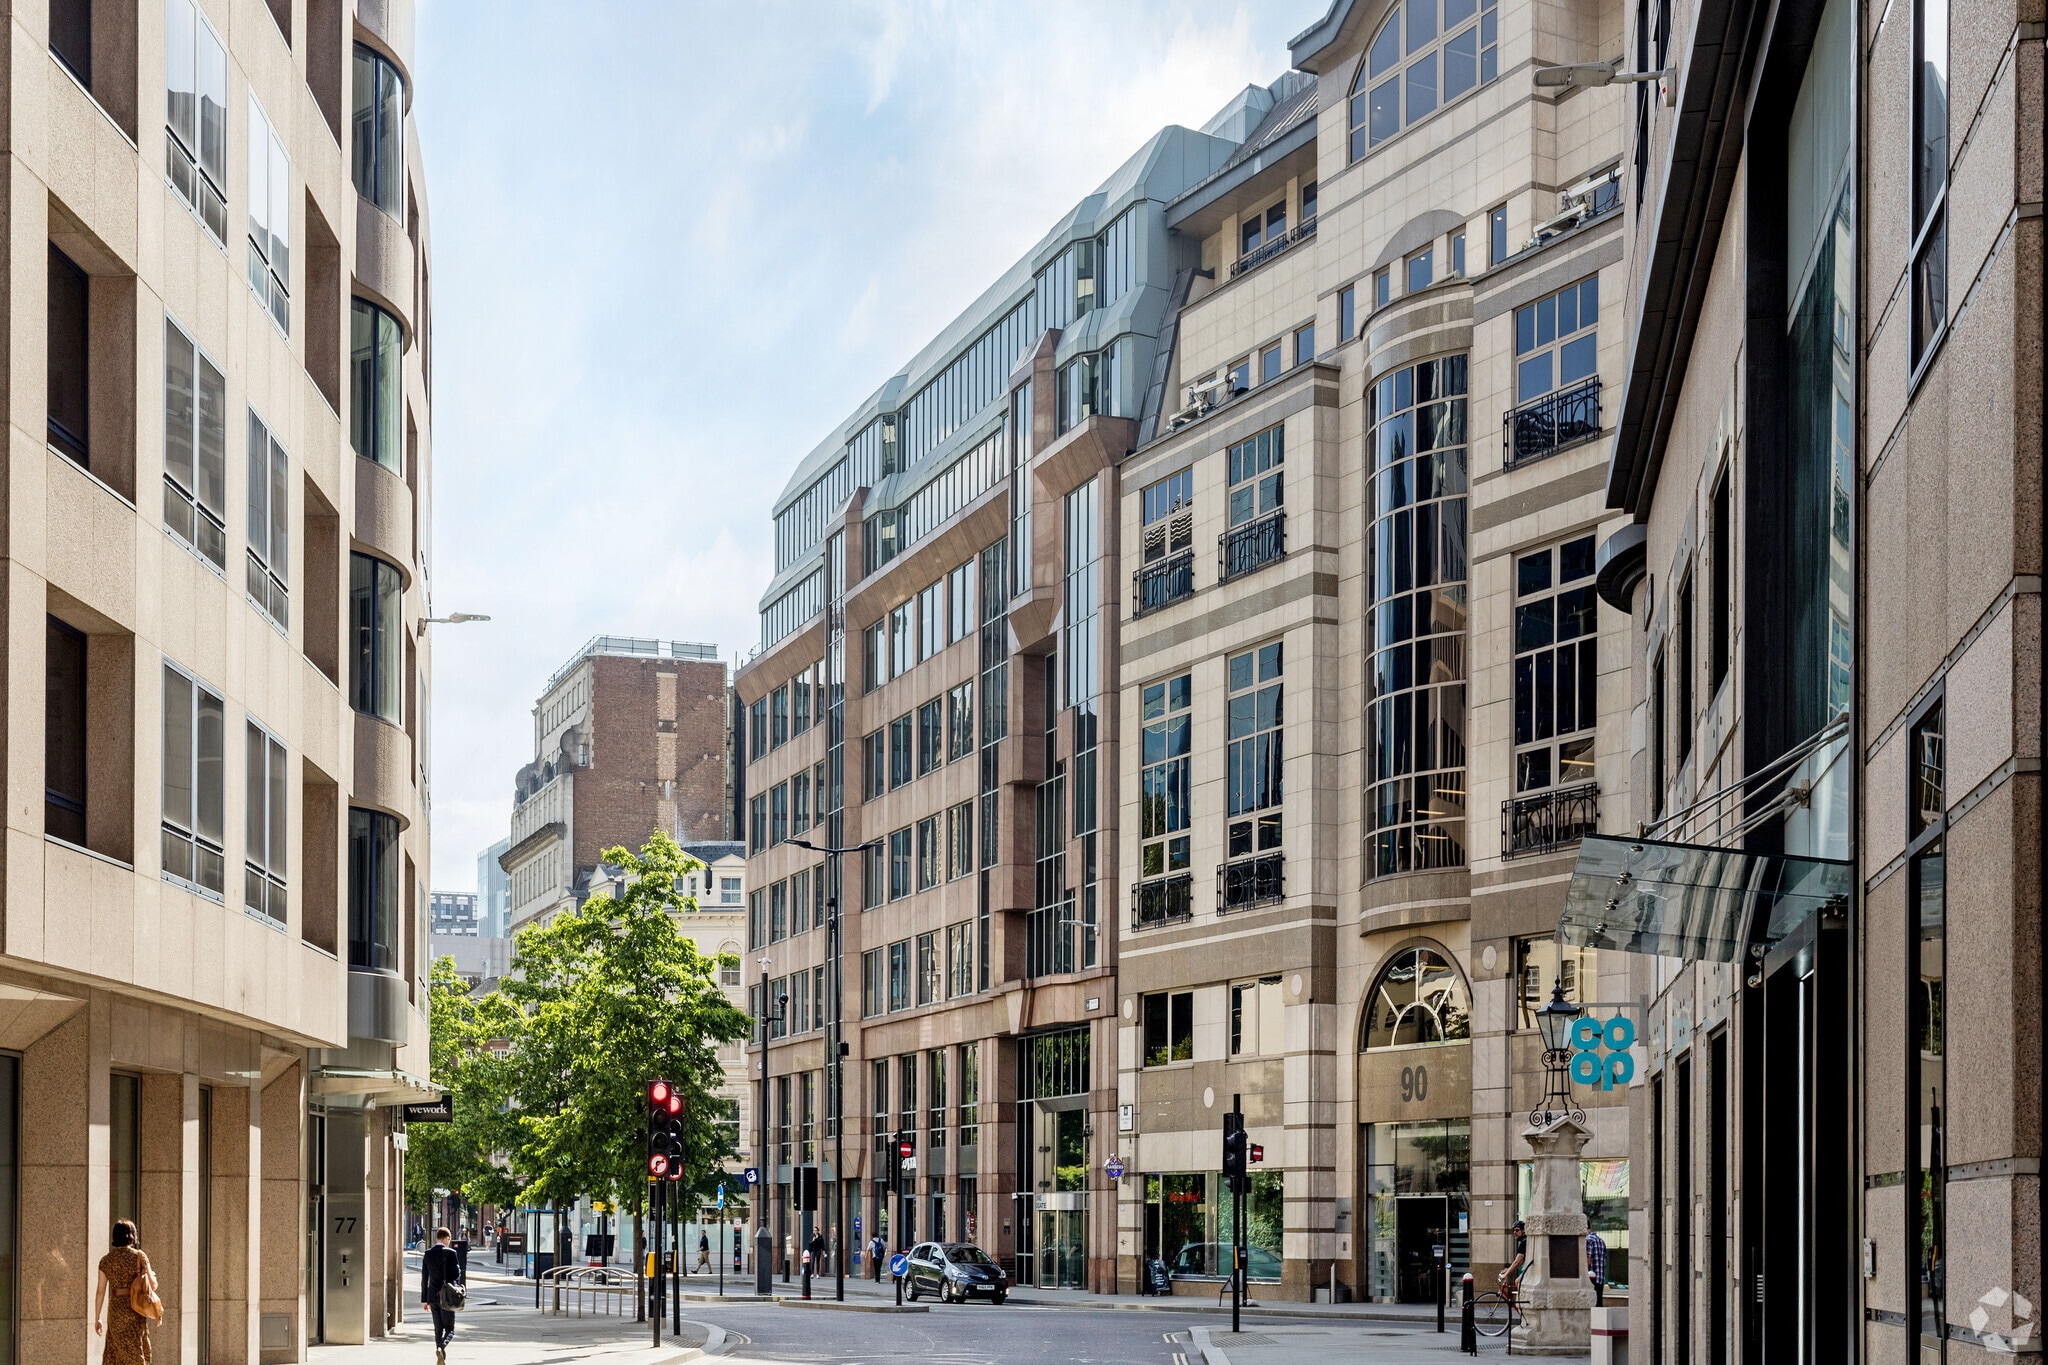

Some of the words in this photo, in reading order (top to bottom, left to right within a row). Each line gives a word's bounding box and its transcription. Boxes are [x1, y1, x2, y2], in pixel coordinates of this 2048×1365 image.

[1401, 1065, 1427, 1102] 90
[408, 1103, 447, 1114] wework
[335, 1217, 357, 1234] 77
